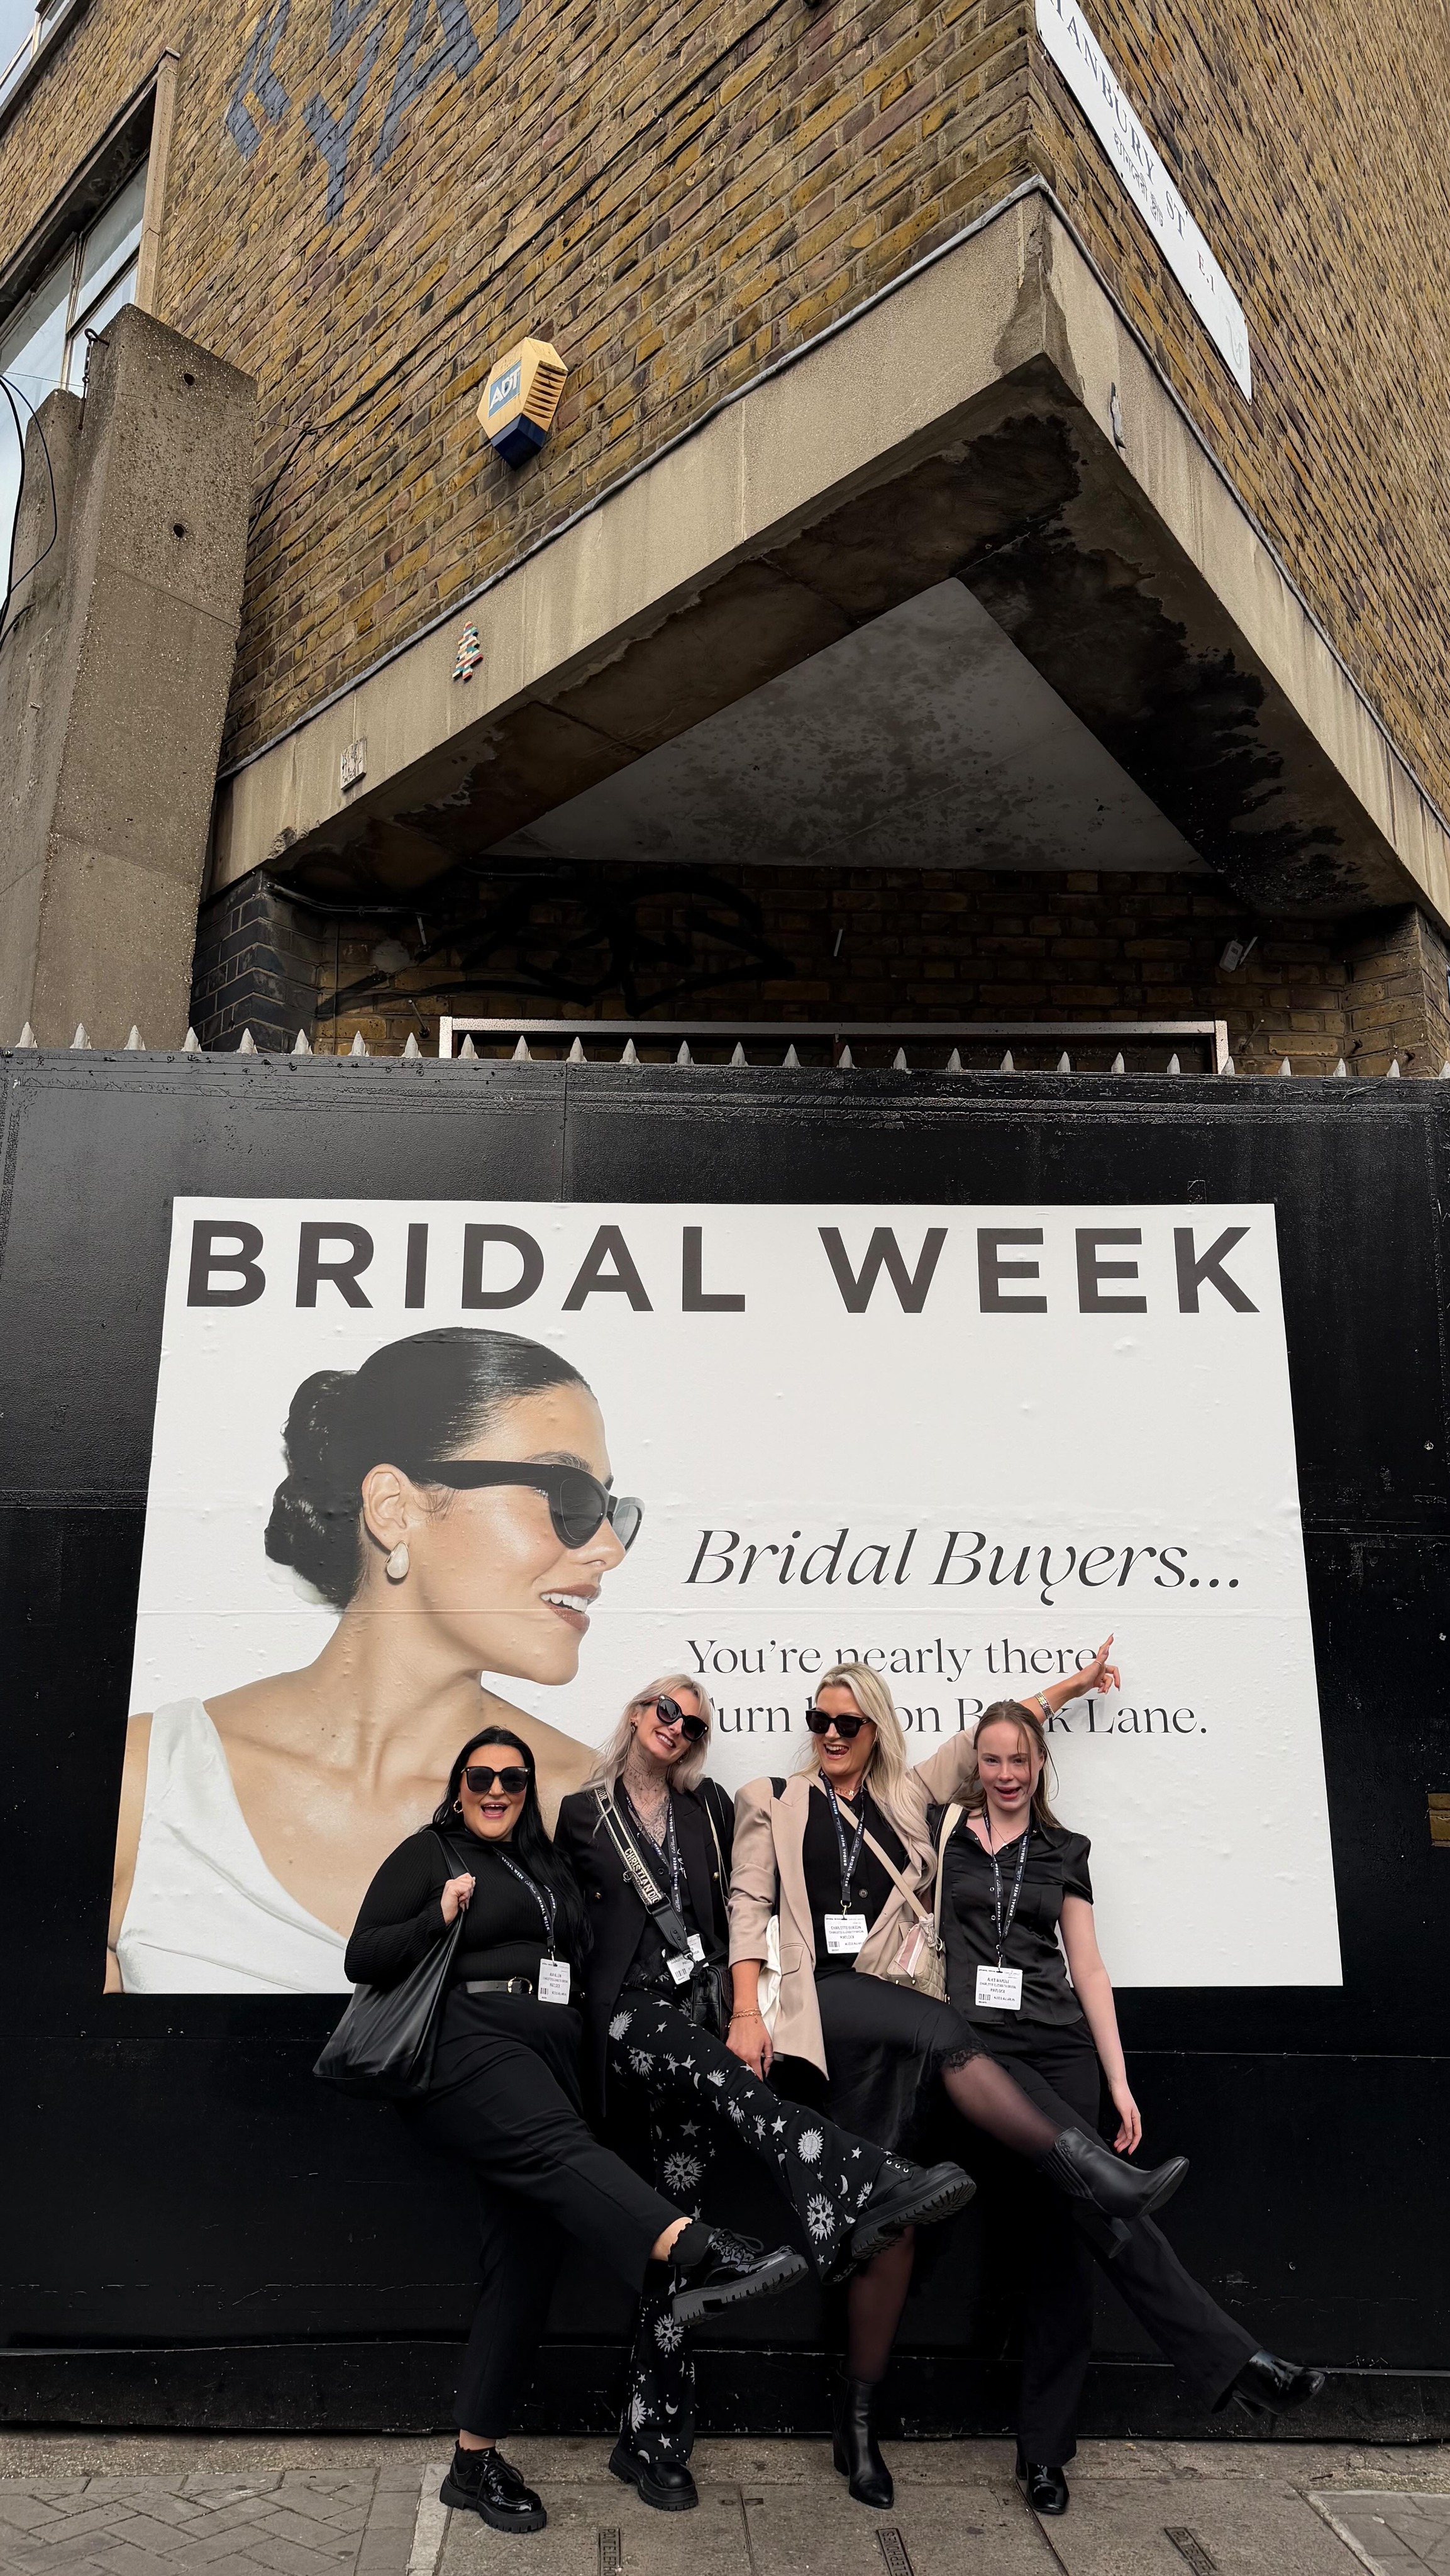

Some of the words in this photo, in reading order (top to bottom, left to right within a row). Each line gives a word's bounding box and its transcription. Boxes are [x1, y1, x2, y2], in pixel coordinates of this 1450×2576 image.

[1166, 191, 1185, 241] ST
[489, 366, 521, 410] ADT
[186, 1219, 745, 1312] BRIDAL
[818, 1226, 1260, 1313] WEEK
[681, 1528, 917, 1585] Bridal
[931, 1531, 1239, 1606] Buyers...
[685, 1640, 822, 1674] You’re
[835, 1638, 973, 1682] nearly
[709, 1697, 793, 1733] urn
[1085, 1698, 1207, 1734] Lane.
